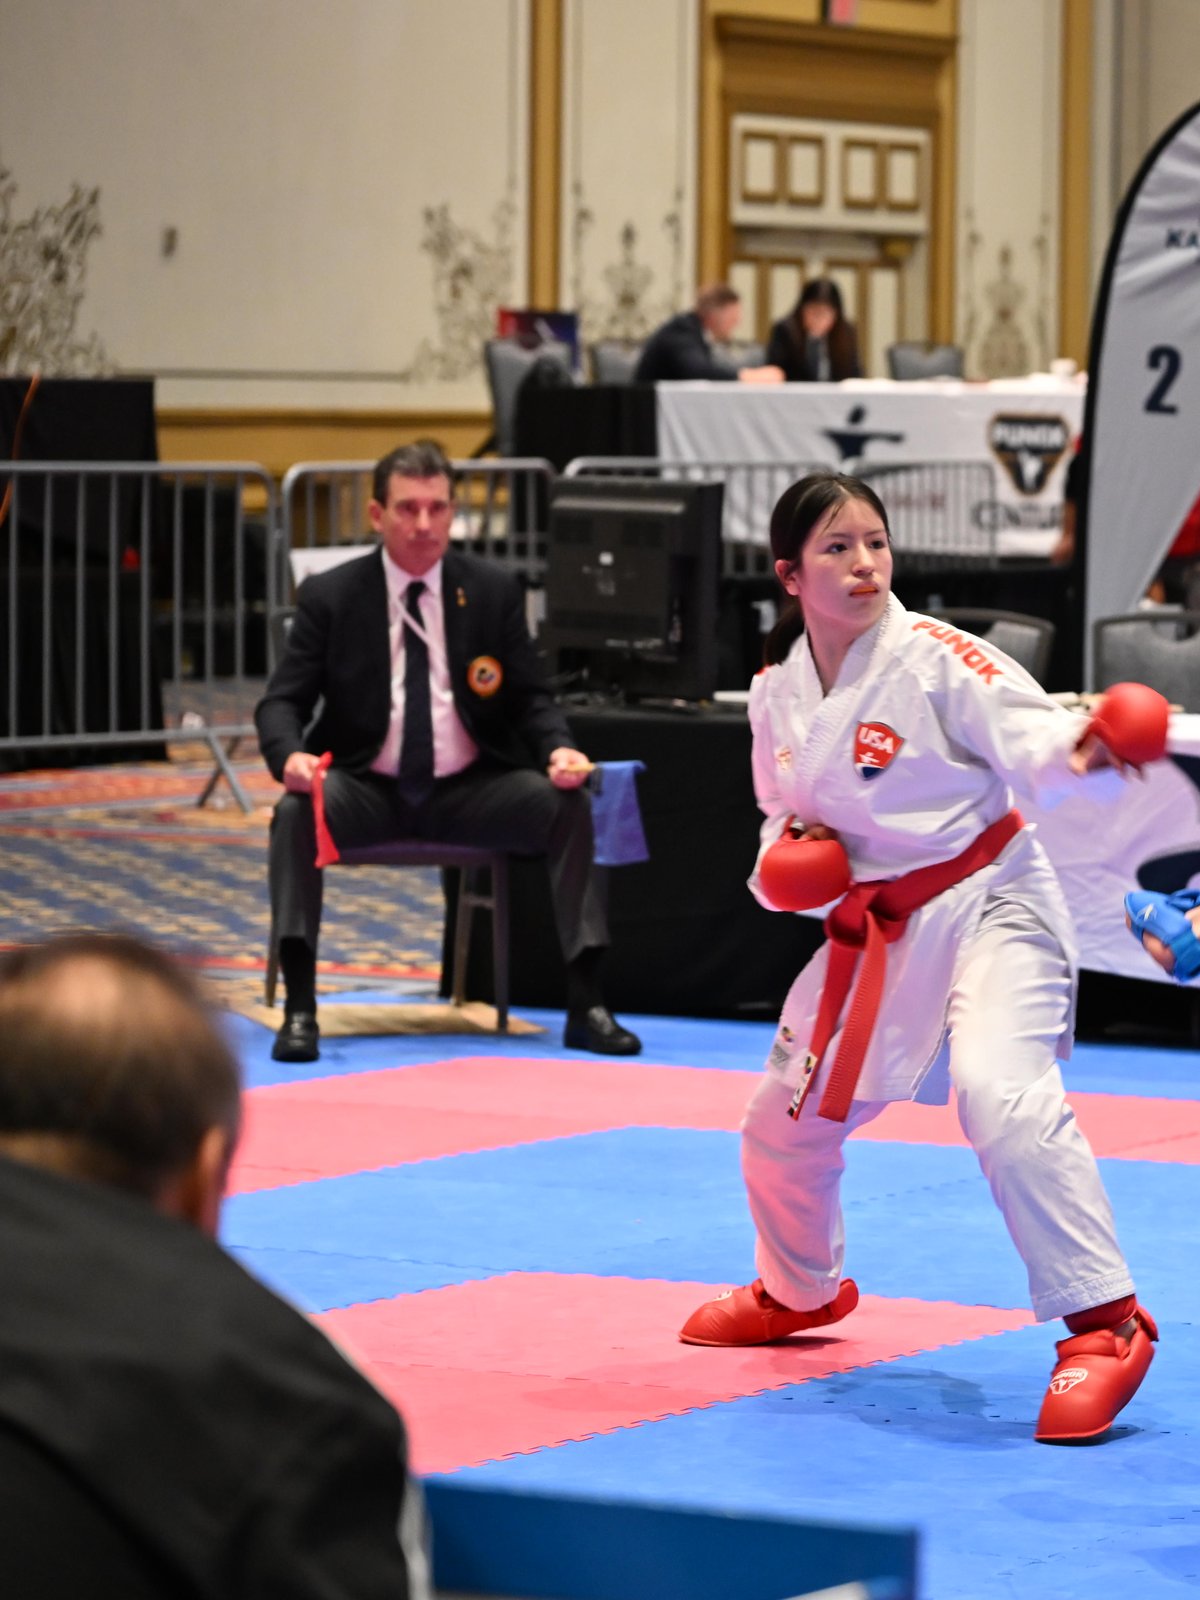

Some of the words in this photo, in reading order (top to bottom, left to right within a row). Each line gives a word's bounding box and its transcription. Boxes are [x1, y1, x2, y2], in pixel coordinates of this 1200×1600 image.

[1144, 343, 1182, 416] 2
[911, 620, 1005, 686] PUNOK
[858, 726, 895, 754] USA
